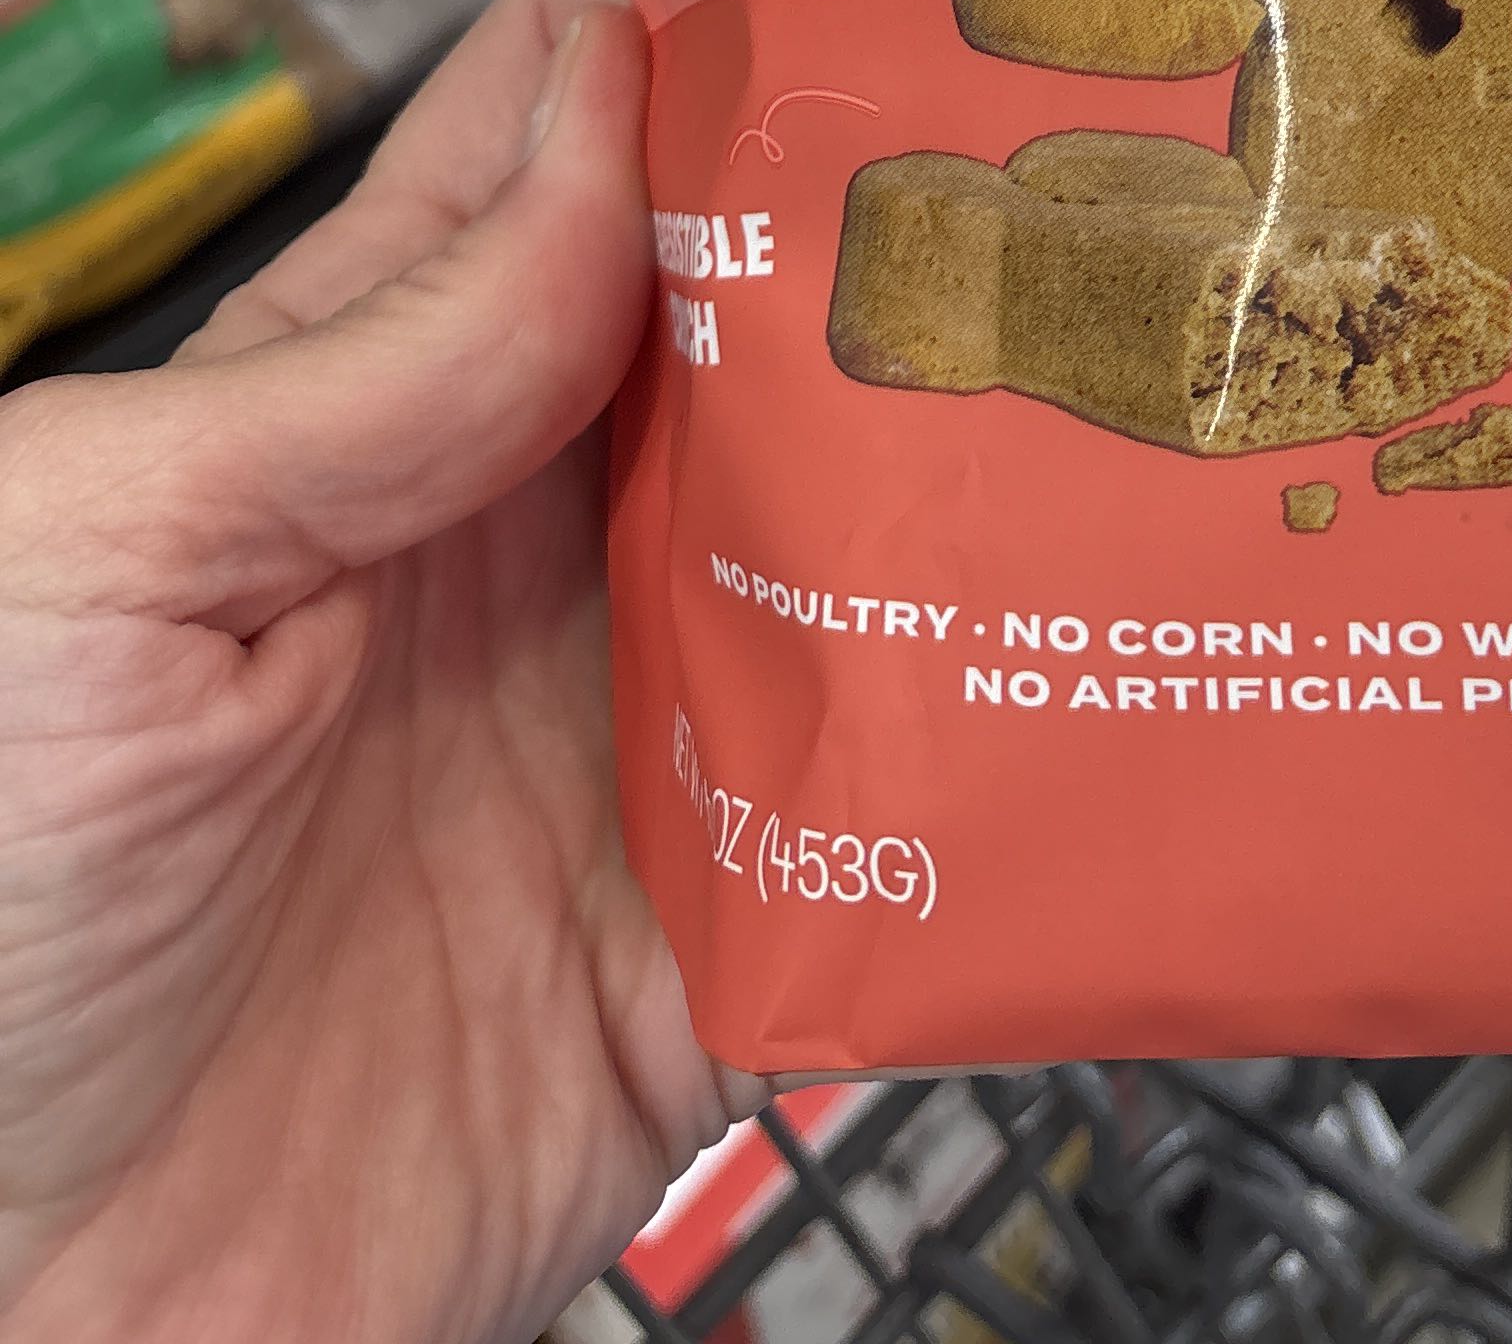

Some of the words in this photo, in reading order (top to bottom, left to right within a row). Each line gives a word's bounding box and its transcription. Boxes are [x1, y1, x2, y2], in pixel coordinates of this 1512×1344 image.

[709, 552, 750, 600] NO
[752, 573, 960, 643] POULTRY
[1002, 613, 1090, 654] NO
[1107, 618, 1294, 657] CORN
[1347, 618, 1443, 657] NO
[963, 665, 1051, 709] NO
[1067, 674, 1444, 713] ARTIFICIAL
[757, 810, 938, 922] (453G)
